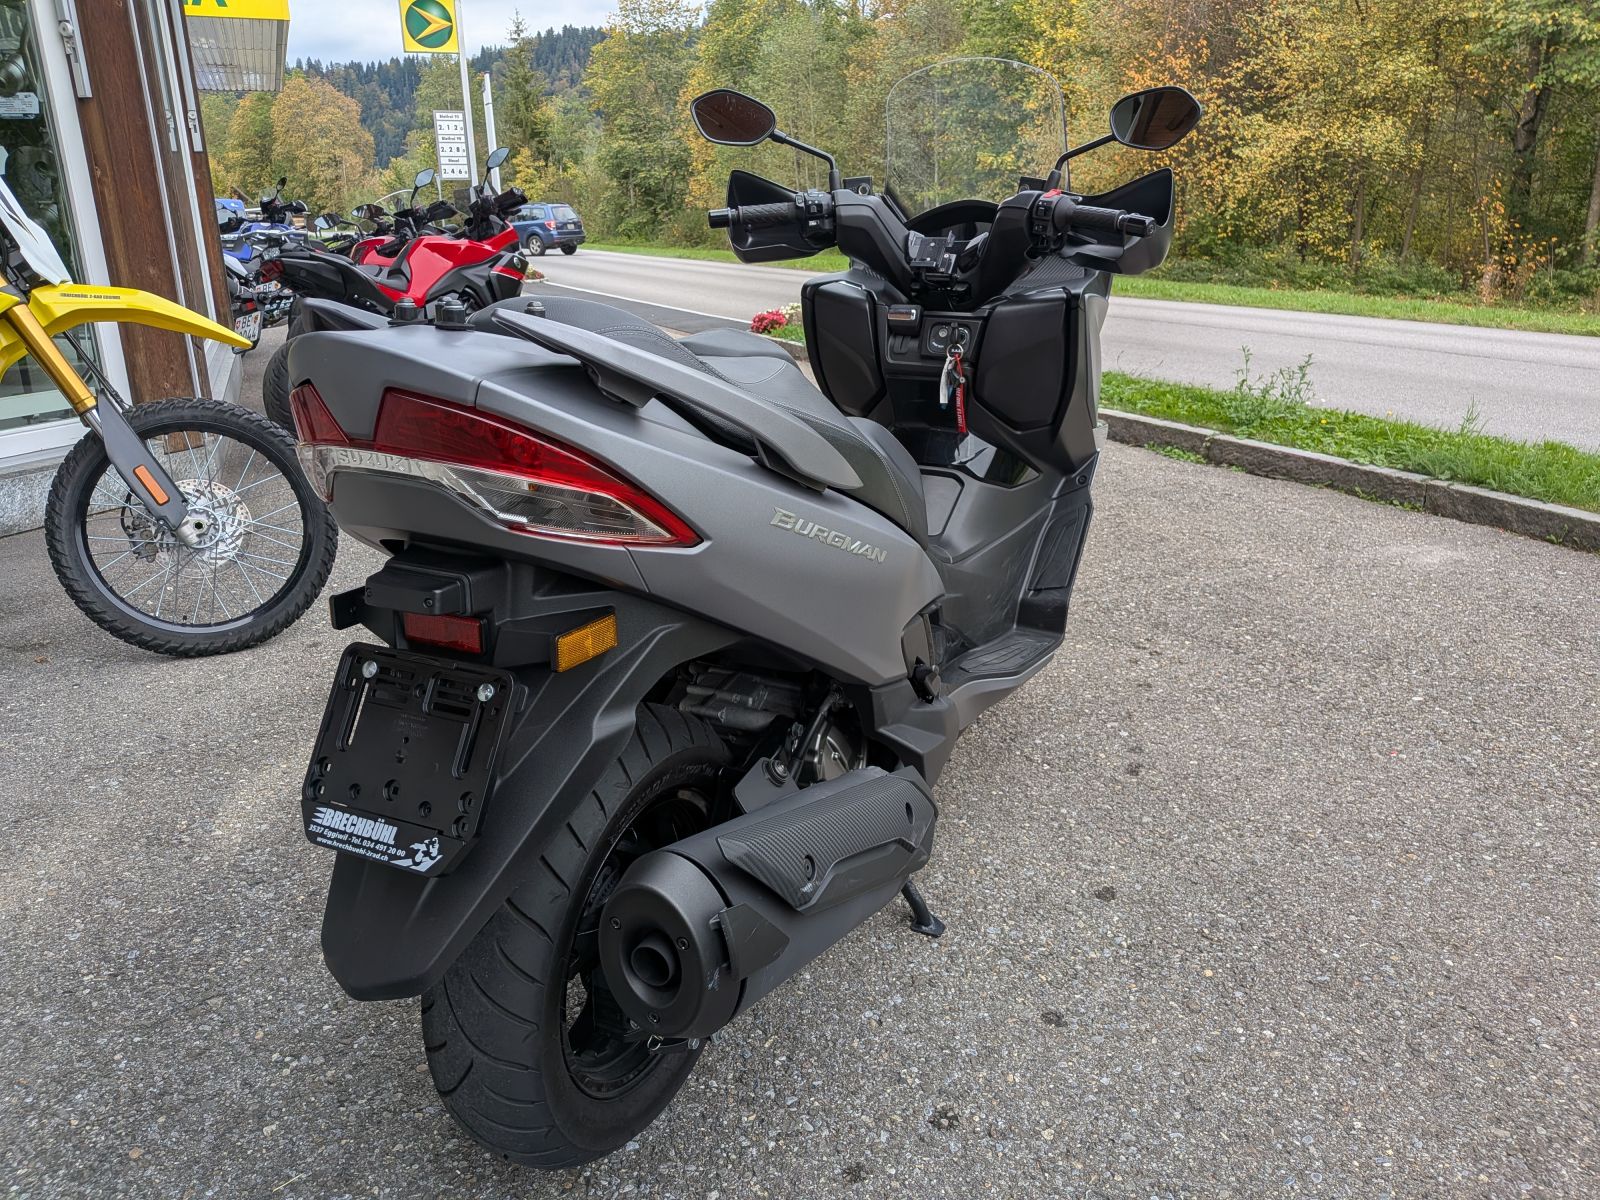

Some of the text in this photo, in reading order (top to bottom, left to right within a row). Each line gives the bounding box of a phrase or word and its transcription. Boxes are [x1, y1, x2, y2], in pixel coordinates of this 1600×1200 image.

[241, 314, 253, 329] BE
[770, 507, 887, 563] BURGMAN
[308, 824, 324, 834] 3537
[323, 829, 348, 841] Eggiwil
[362, 840, 375, 849] 034
[375, 843, 387, 852] 491
[396, 849, 406, 857] 00
[320, 808, 398, 845] BRECHBÜHL
